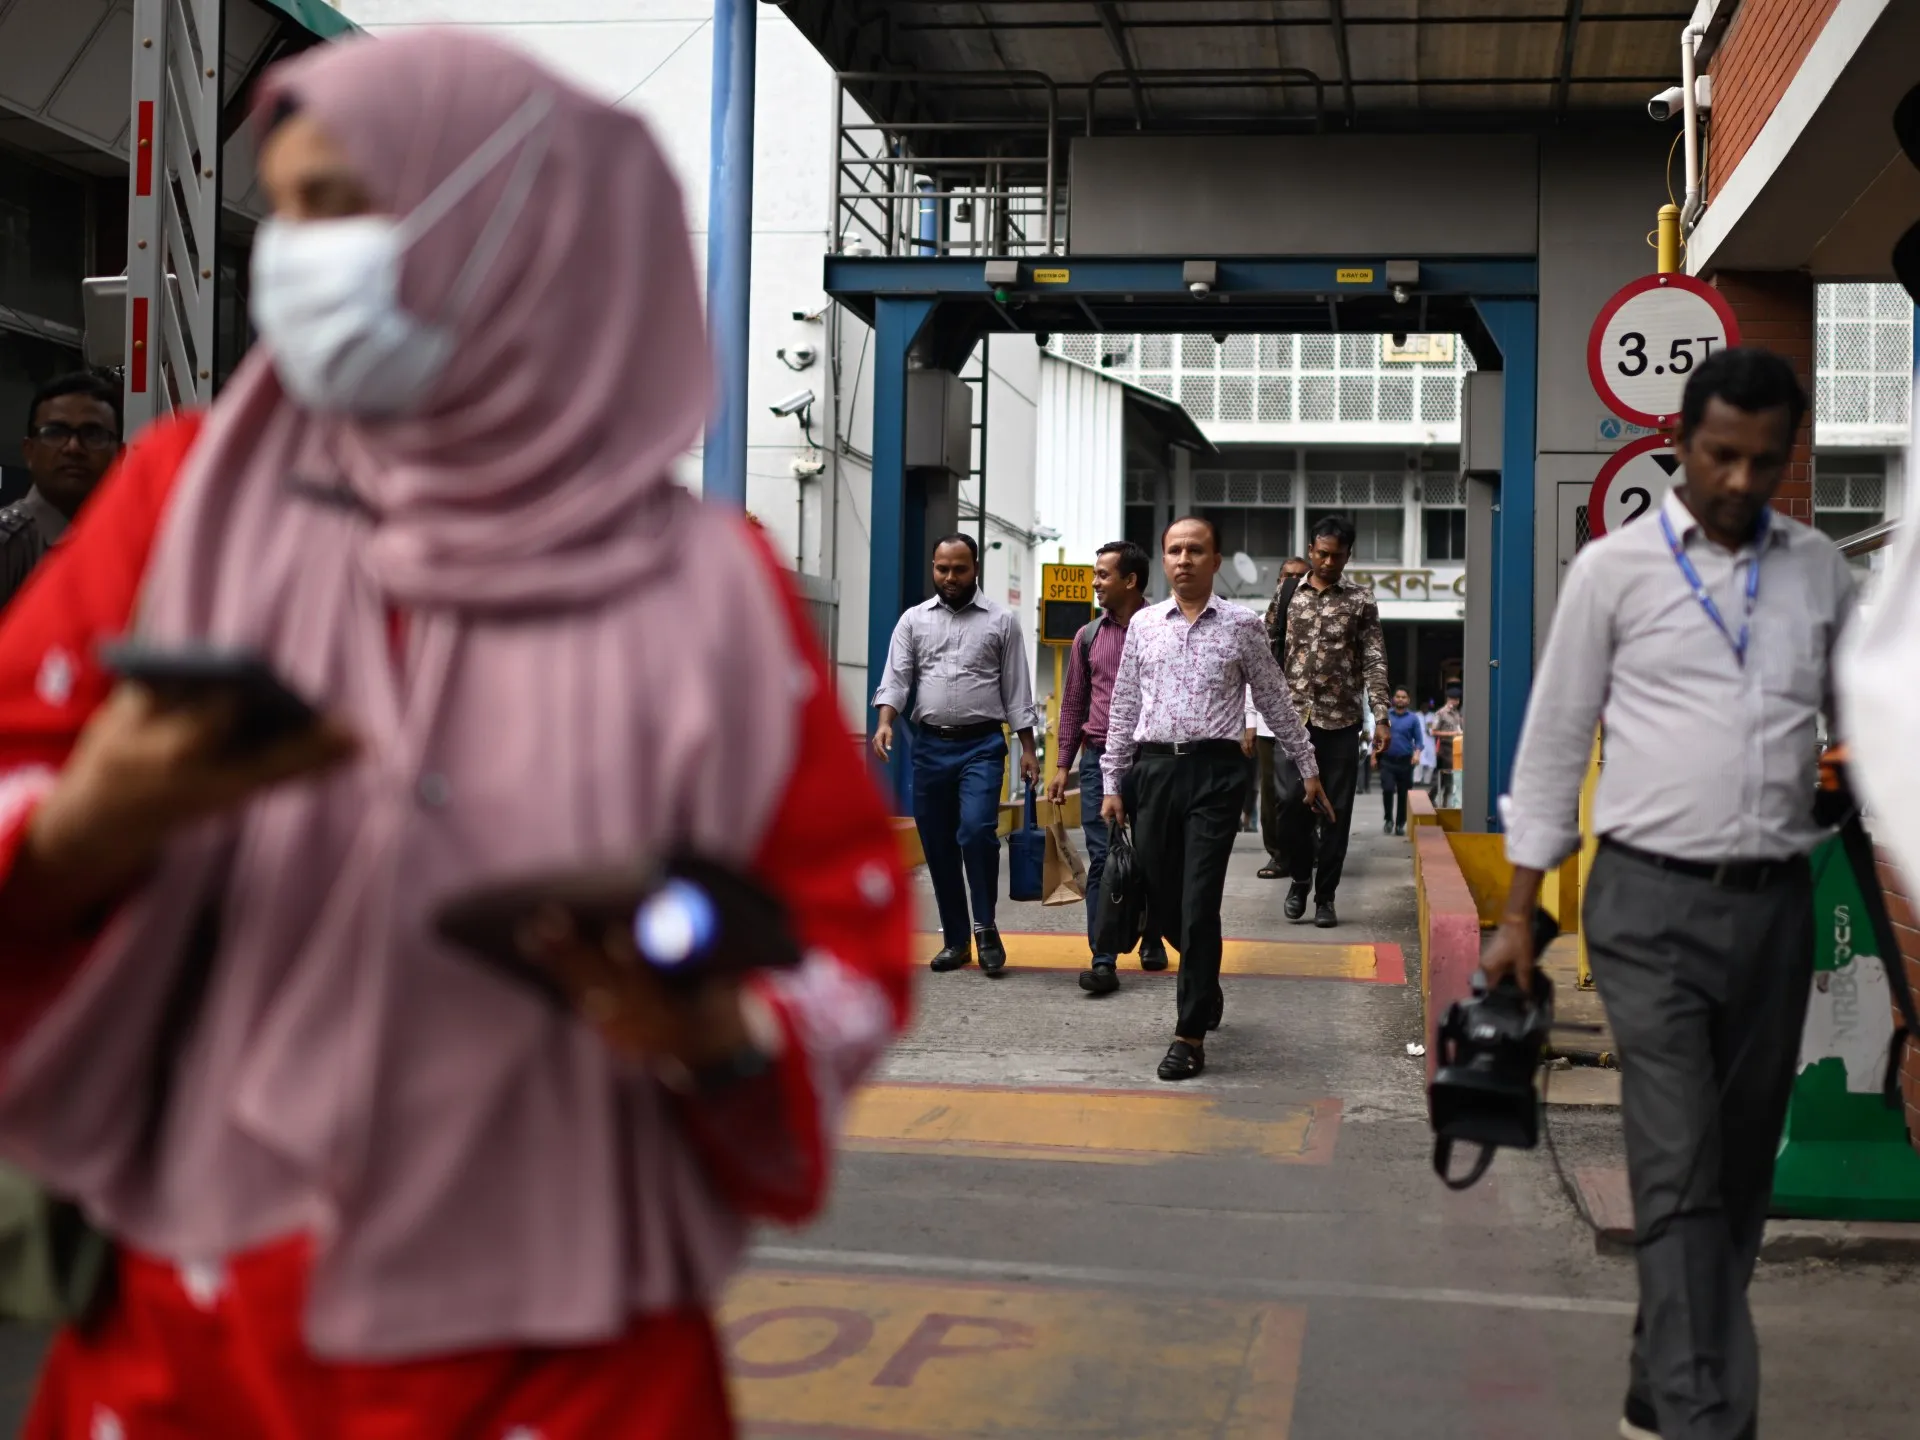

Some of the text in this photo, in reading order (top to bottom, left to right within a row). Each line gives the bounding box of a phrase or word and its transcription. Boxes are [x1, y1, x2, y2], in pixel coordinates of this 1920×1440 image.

[1620, 486, 1651, 527] 2
[1053, 567, 1084, 582] YOUR
[1050, 584, 1088, 599] SPEED
